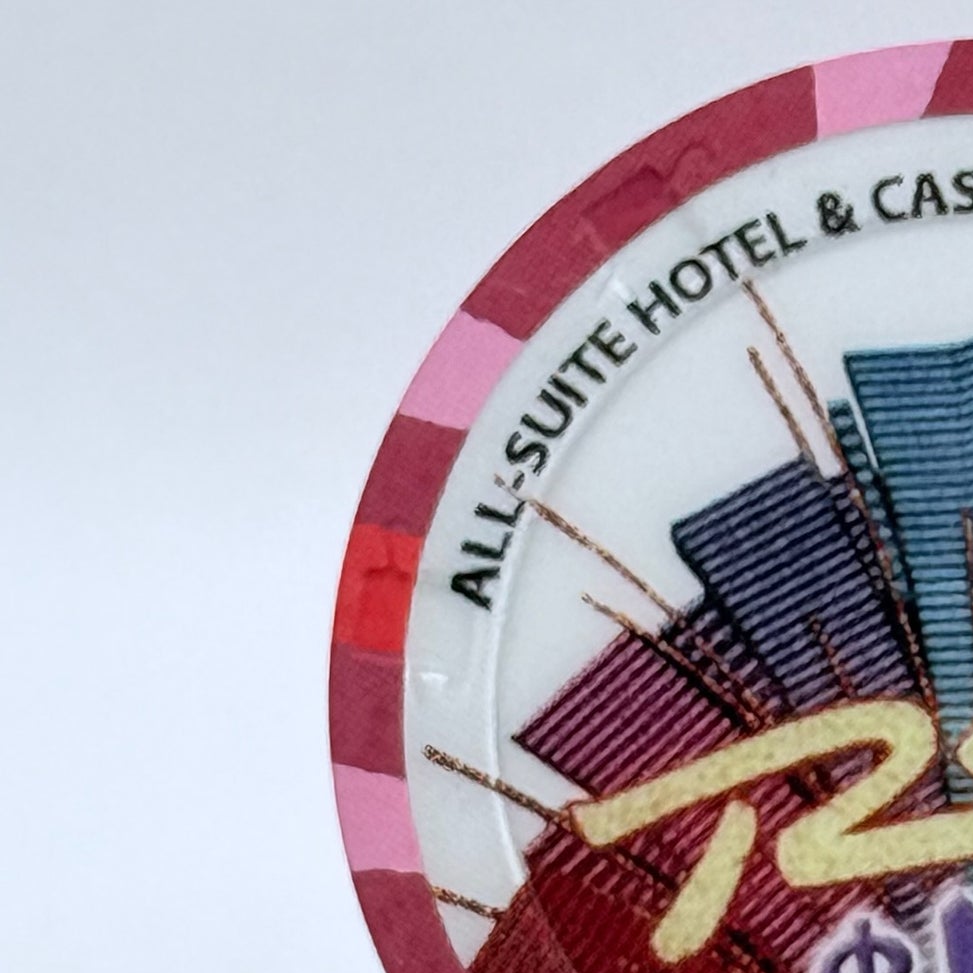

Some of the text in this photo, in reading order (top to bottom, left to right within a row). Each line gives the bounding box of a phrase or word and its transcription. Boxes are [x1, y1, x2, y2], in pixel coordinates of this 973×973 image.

[451, 319, 638, 611] ALL-SUITE
[627, 212, 807, 335] HOTEL
[816, 191, 861, 235] &
